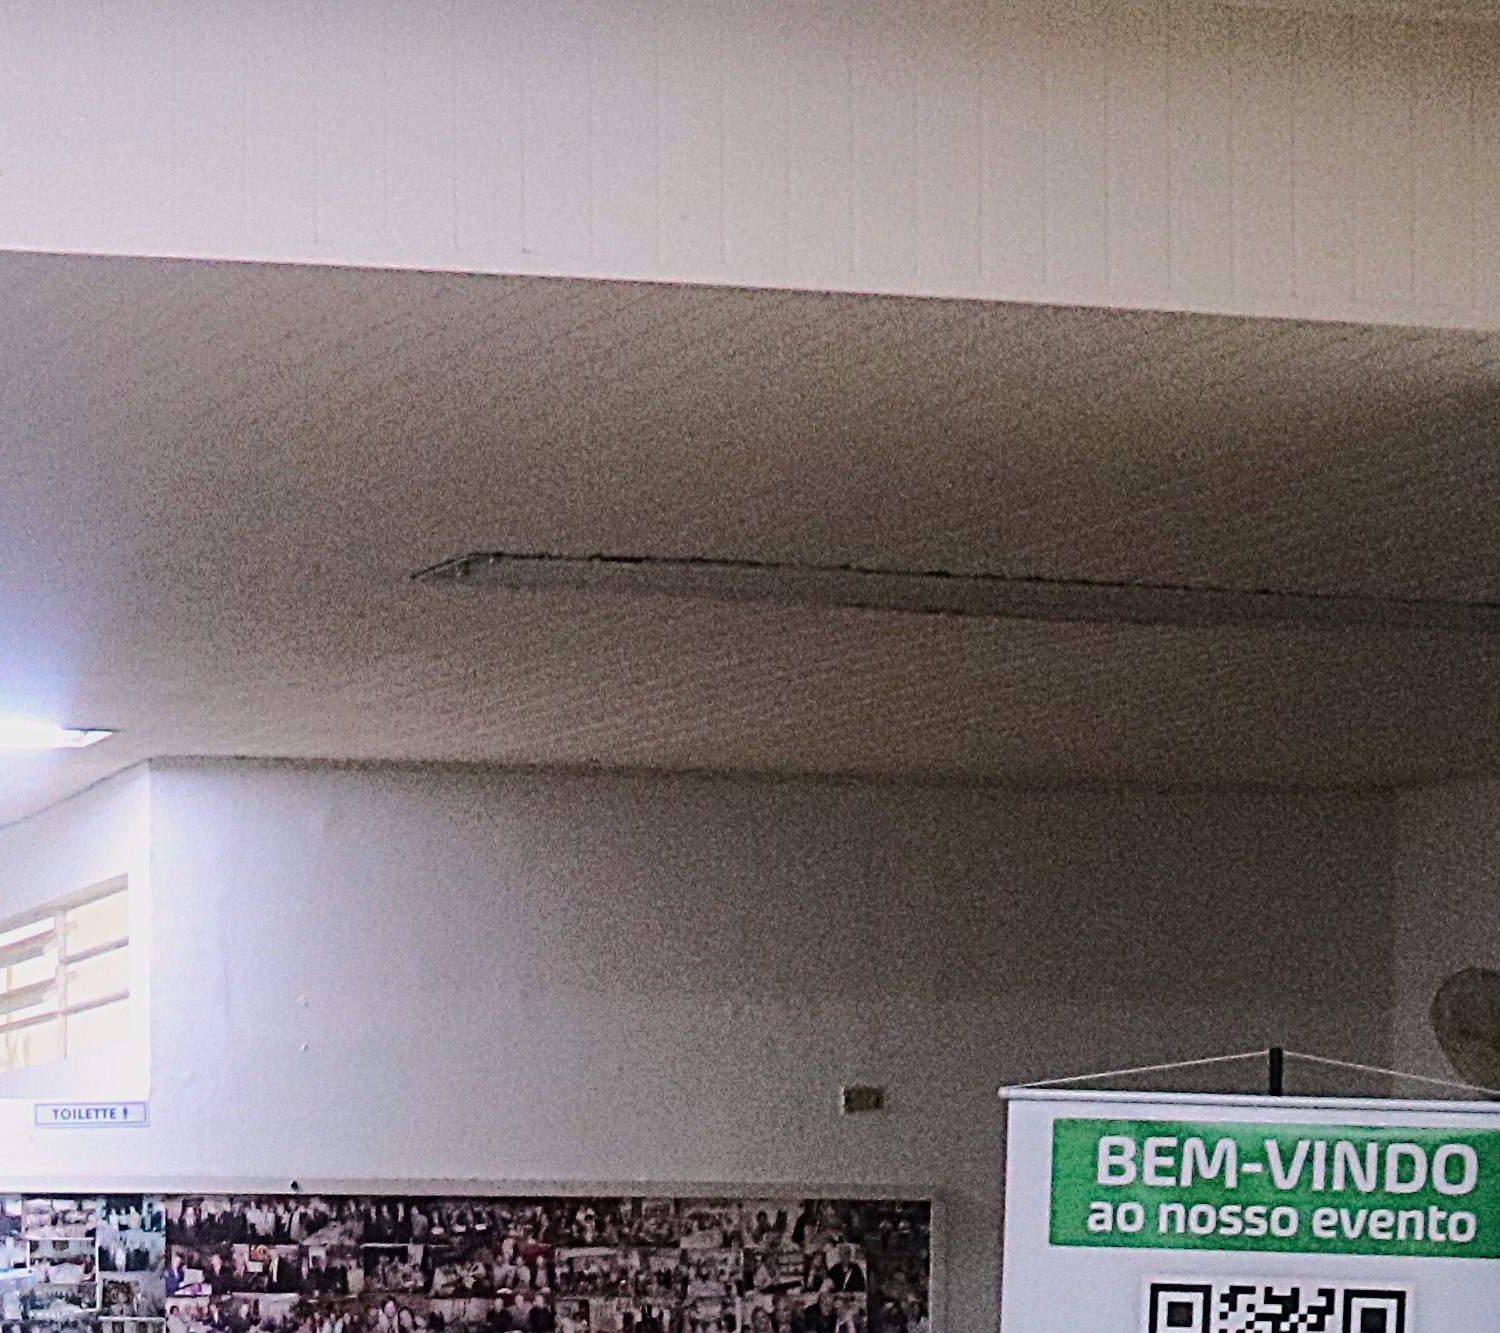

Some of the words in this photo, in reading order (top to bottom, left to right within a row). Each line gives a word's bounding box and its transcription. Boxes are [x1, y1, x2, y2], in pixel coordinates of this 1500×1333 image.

[52, 1107, 117, 1121] TOILETTE
[1095, 1133, 1480, 1197] BEM-VINDO
[1086, 1201, 1145, 1234] ao
[1157, 1202, 1299, 1238] nosso
[1312, 1205, 1478, 1244] evento
